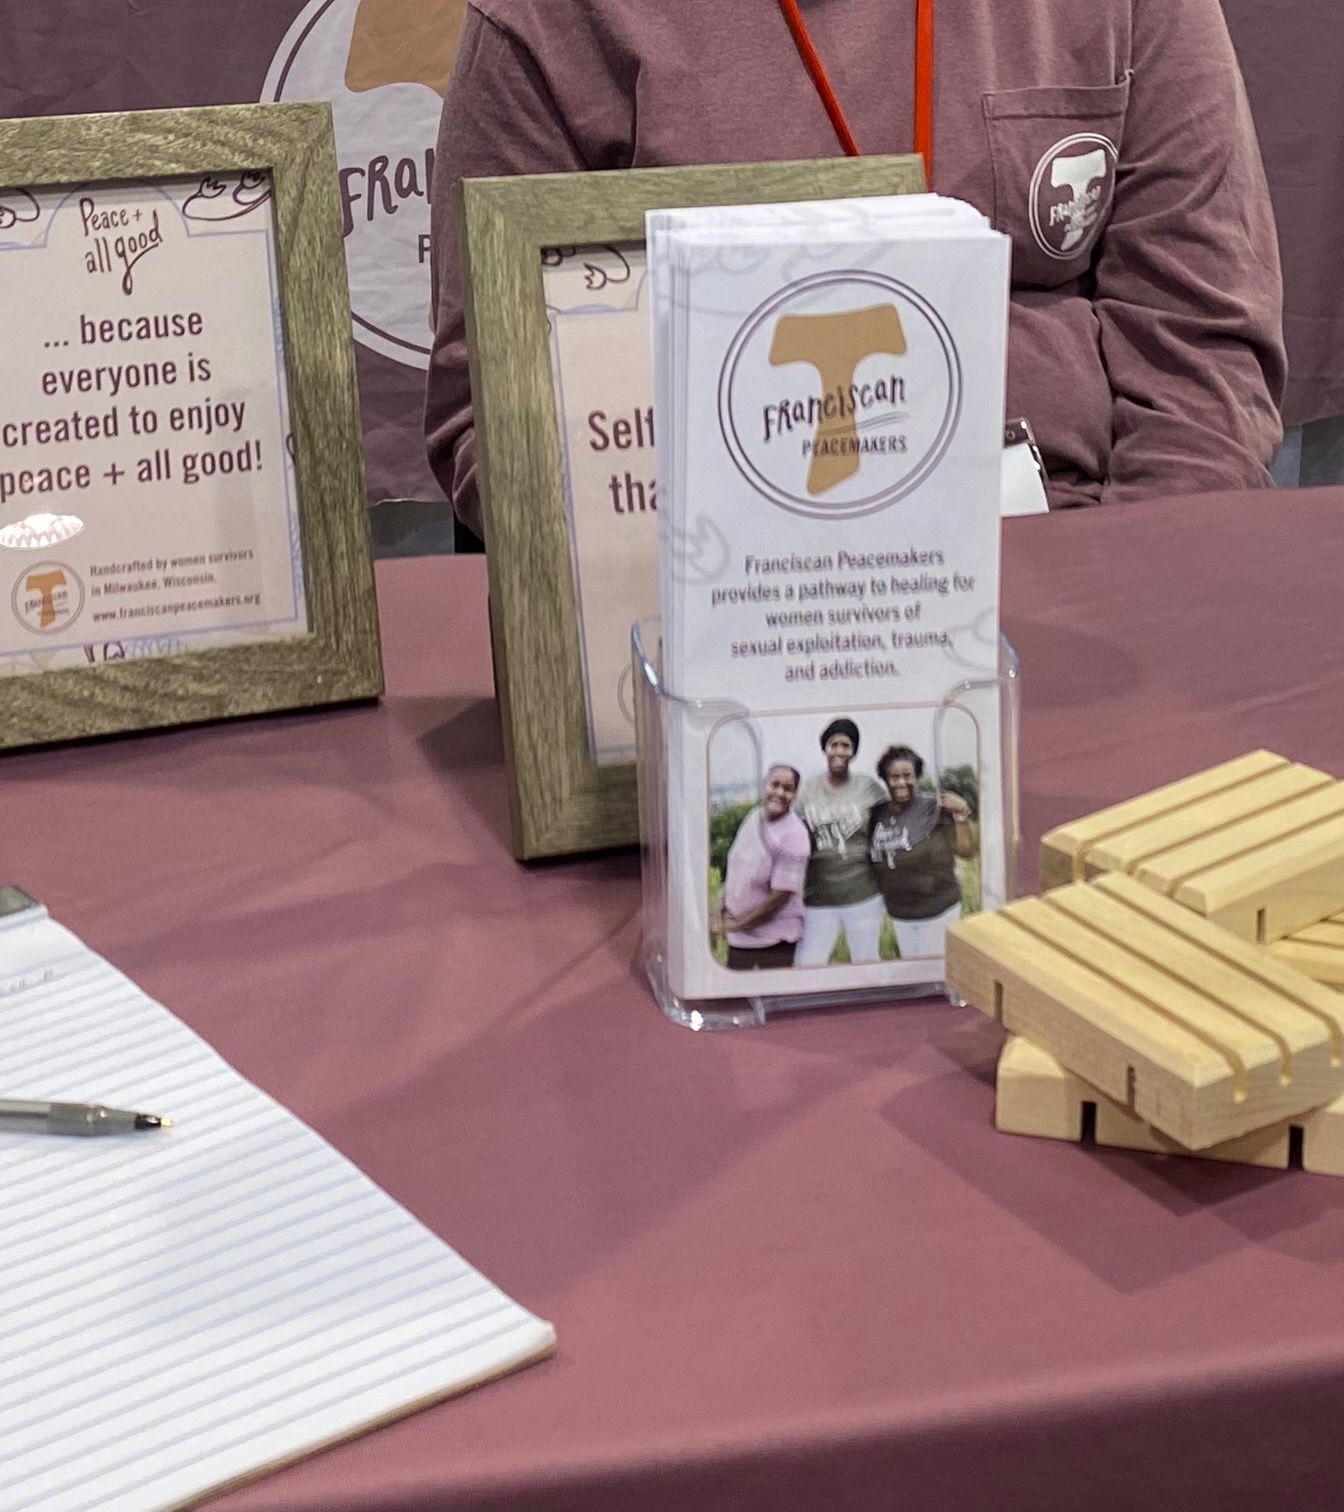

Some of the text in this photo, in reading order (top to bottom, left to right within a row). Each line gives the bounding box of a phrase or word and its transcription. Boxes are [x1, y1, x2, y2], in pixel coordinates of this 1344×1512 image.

[80, 197, 129, 236] Peace
[84, 209, 163, 295] all good
[80, 312, 203, 344] because
[42, 352, 211, 396] everyone is
[3, 397, 245, 448] created to enjoy
[802, 436, 908, 456] PEACEMAKERS
[0, 440, 263, 503] peace + all good!
[90, 549, 254, 577] Handcrafted by women survivors
[745, 547, 944, 573] Franciscan Peacemakers
[91, 585, 101, 596] in
[711, 572, 974, 607] provides a pathway to healing for
[766, 601, 922, 628] women survivors of
[731, 636, 782, 657] sexual
[785, 662, 815, 682] and
